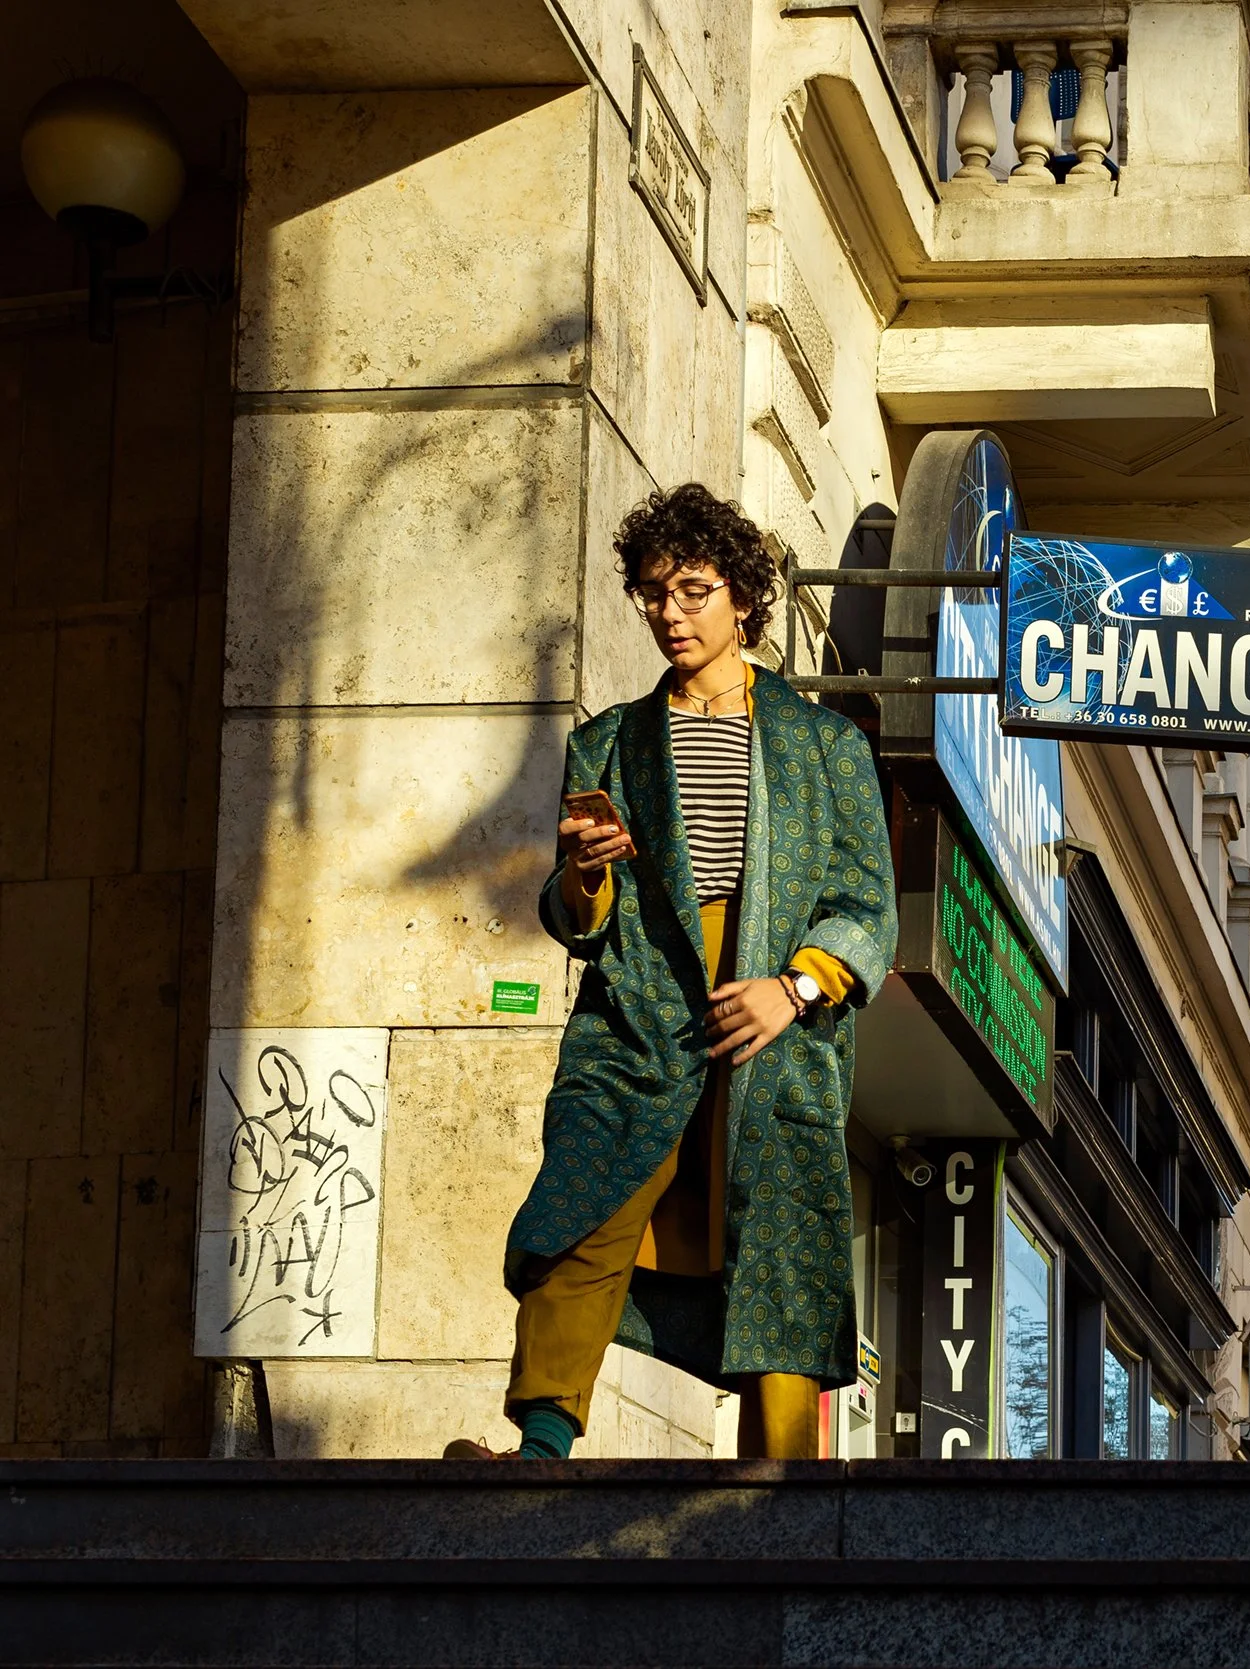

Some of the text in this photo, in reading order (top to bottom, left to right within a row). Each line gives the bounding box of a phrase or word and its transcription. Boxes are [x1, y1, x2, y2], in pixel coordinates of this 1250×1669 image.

[987, 692, 1062, 933] CHANGE
[1097, 711, 1115, 723] 30
[1119, 713, 1147, 726] 658
[1151, 715, 1187, 728] 0801
[943, 884, 1046, 1081] NO COMMISSION
[940, 1151, 975, 1392] CITY
